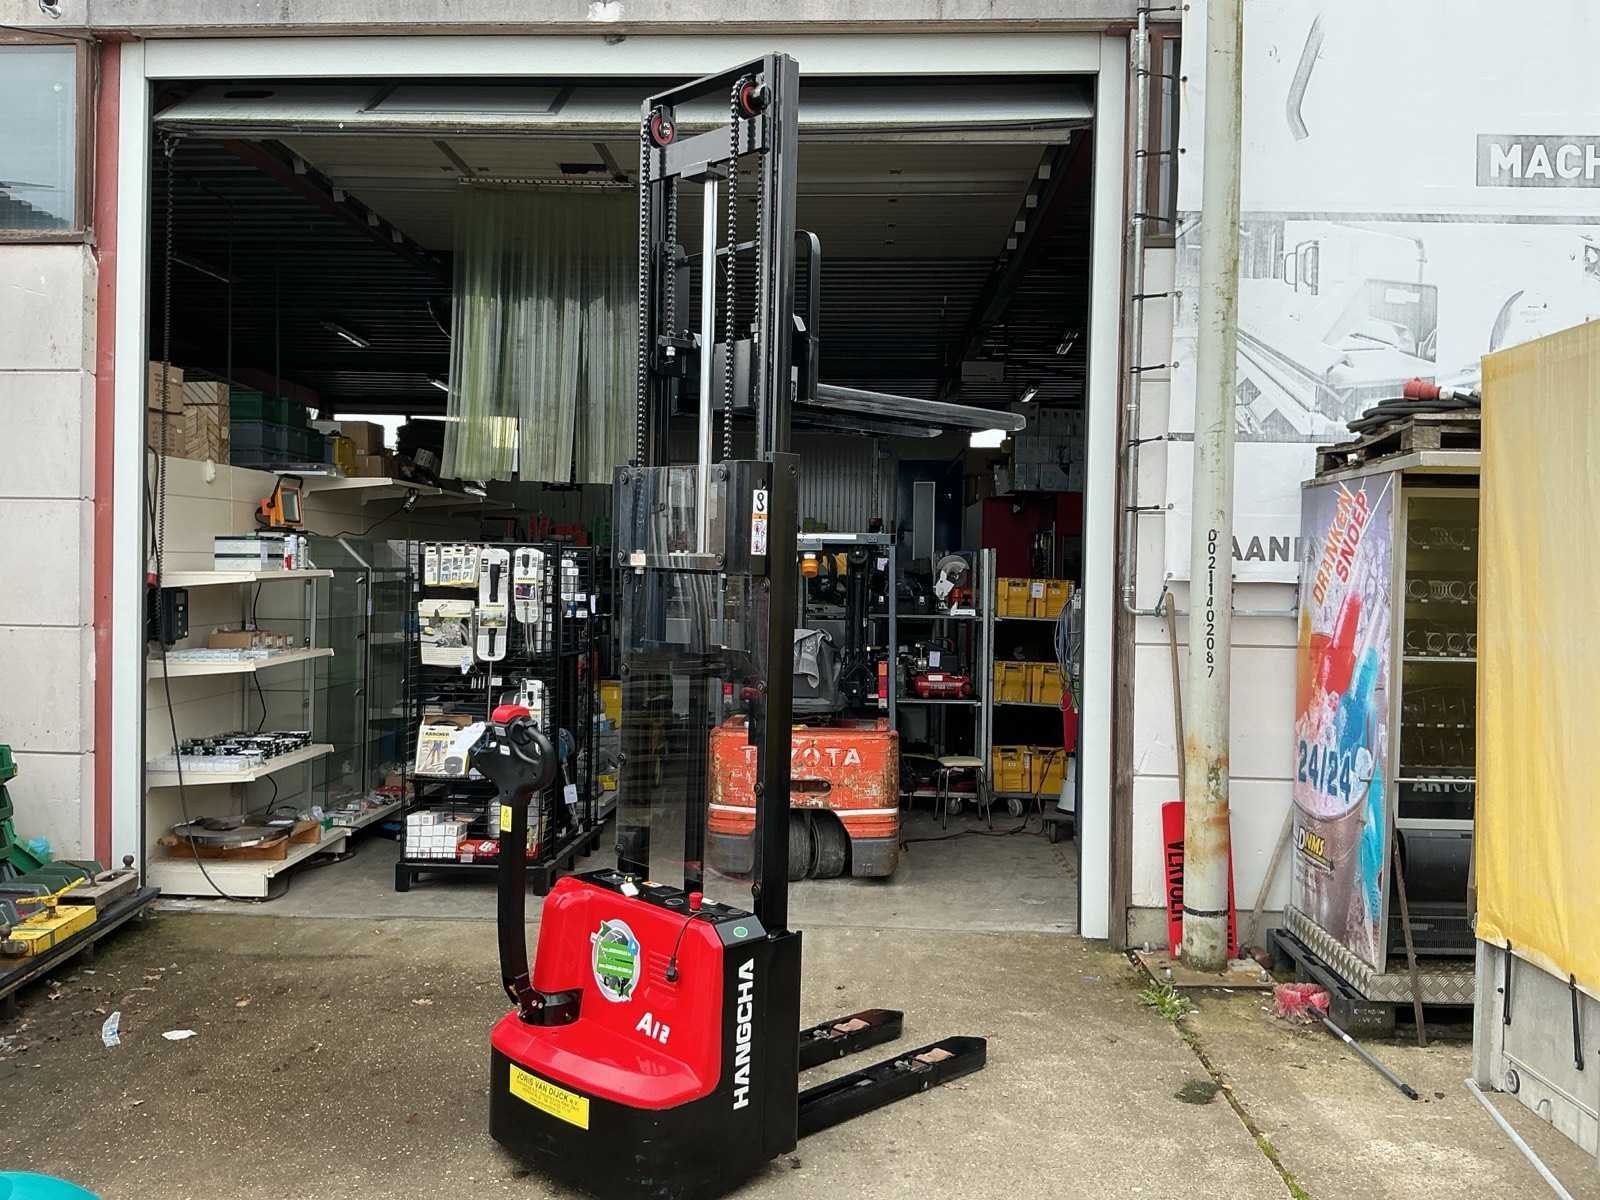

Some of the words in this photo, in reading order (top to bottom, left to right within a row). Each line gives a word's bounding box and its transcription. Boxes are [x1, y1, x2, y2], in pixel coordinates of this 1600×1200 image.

[1336, 491, 1368, 583] SNOEP
[1298, 740, 1351, 804] 24/24
[733, 958, 754, 1111] HANGCHA
[535, 1081, 548, 1093] VAN
